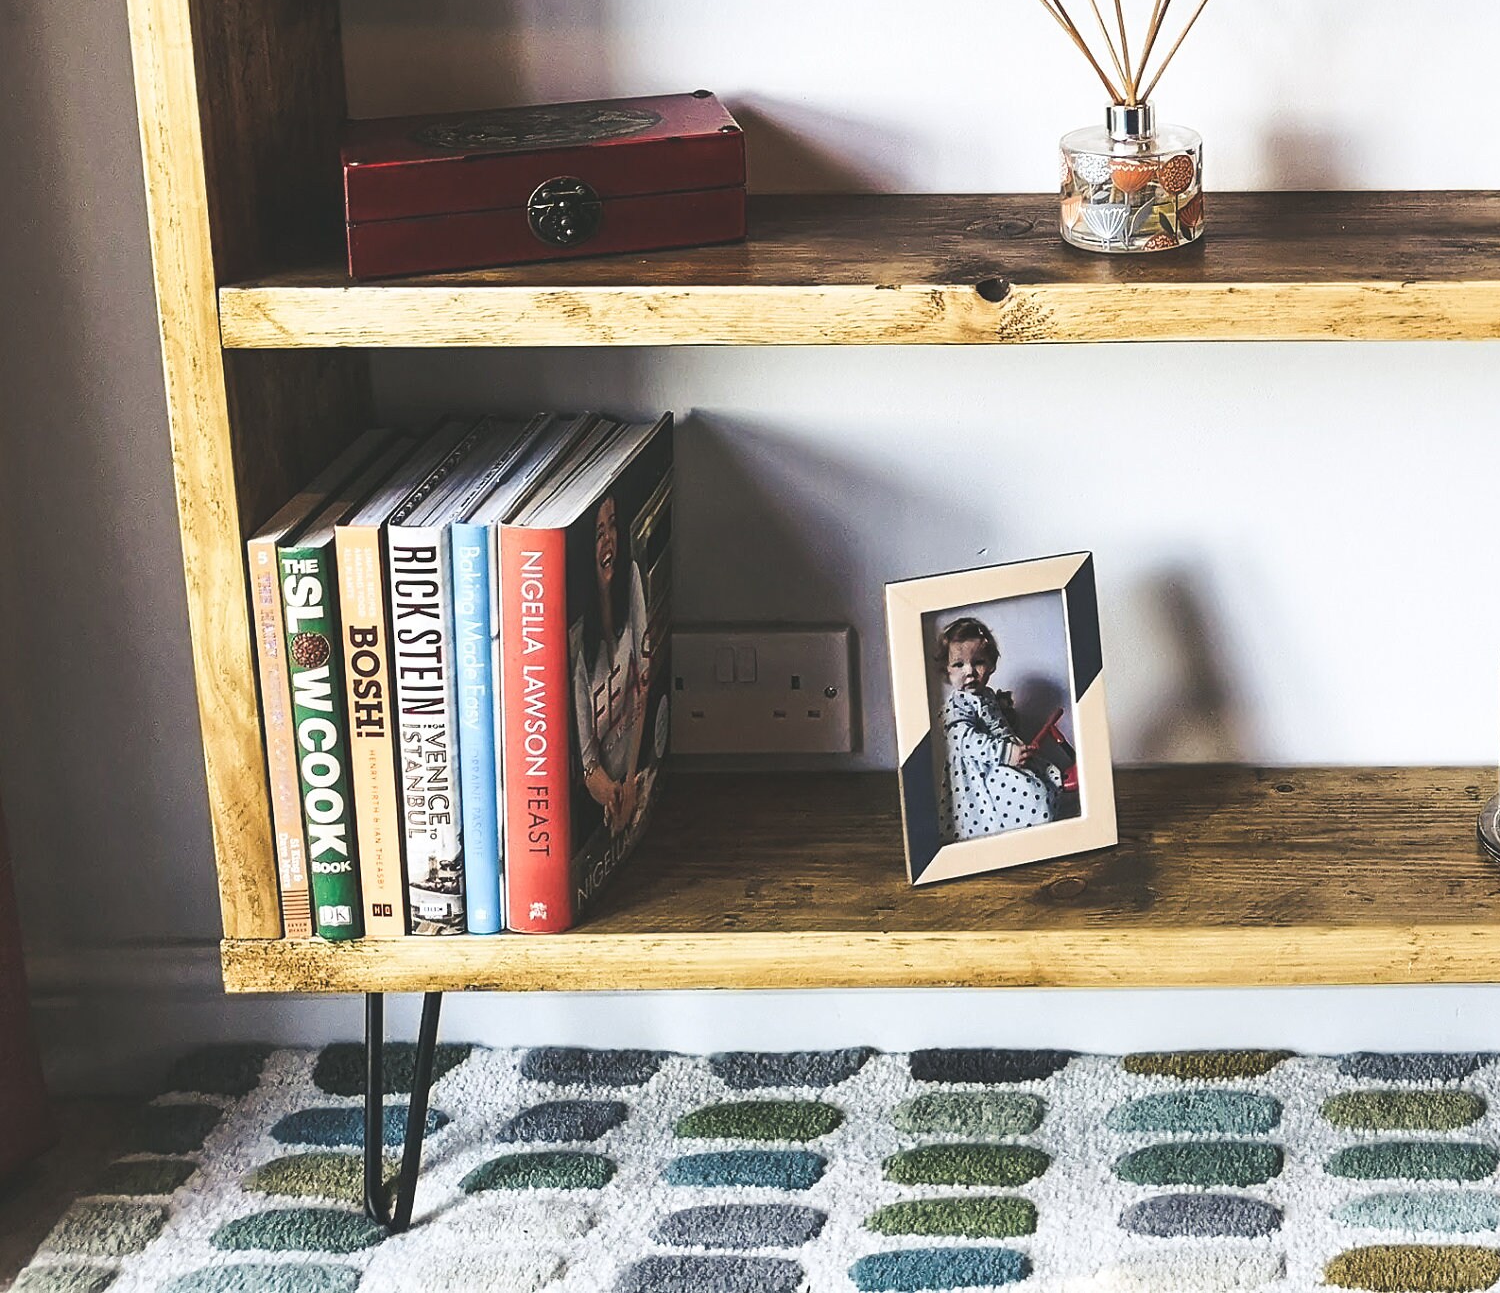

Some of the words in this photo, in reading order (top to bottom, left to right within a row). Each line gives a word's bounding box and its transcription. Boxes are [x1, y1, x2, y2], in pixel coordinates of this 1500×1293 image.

[281, 559, 319, 574] THE
[393, 546, 440, 620] RICK
[458, 545, 482, 615] Baking
[519, 550, 545, 655] NIGELLA
[349, 625, 385, 738] BOSH!
[397, 629, 445, 715] STEIN
[462, 620, 485, 681] Made
[461, 684, 486, 731] Easy
[522, 665, 548, 777] LAWSON
[298, 717, 349, 861] COOK
[368, 749, 378, 781] HENRY
[402, 723, 428, 839] ISTANBUL
[424, 729, 451, 826] VENICE
[370, 785, 380, 814] FIRTH
[526, 786, 550, 857] FEAST
[374, 825, 382, 845] IAN
[429, 827, 438, 840] TO
[312, 860, 352, 874] BOOK
[375, 847, 385, 890] THEASBY
[321, 906, 348, 923] DK
